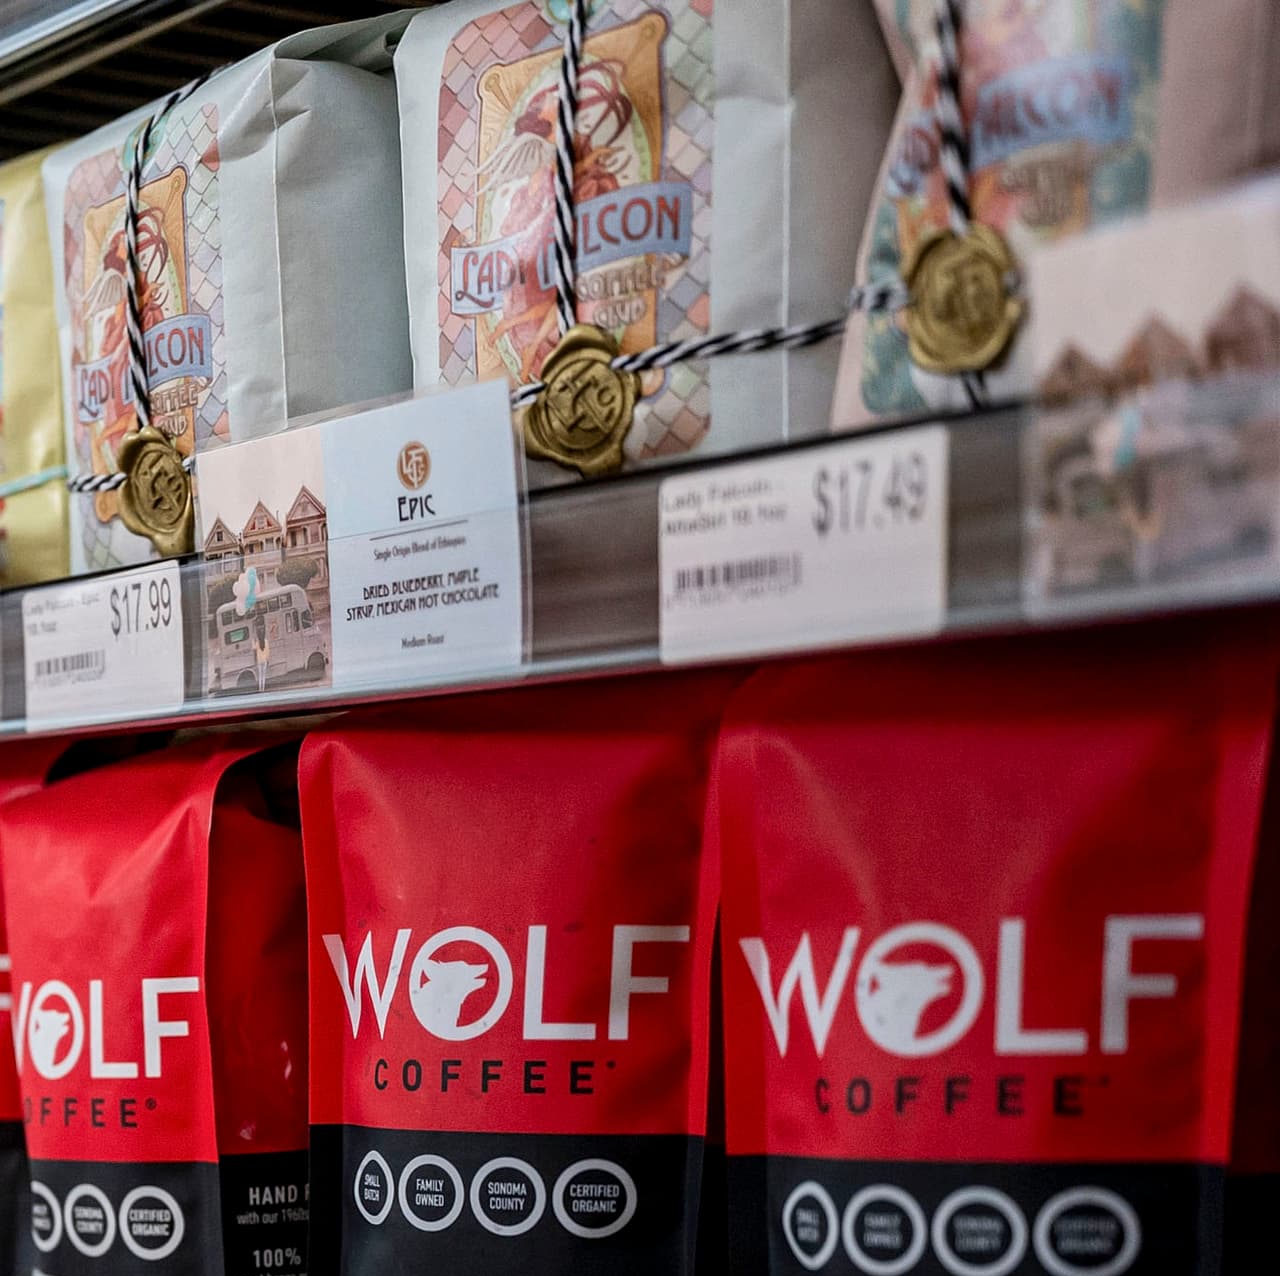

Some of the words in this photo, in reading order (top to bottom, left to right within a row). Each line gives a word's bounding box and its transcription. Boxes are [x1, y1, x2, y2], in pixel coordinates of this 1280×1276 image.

[812, 450, 928, 539] $17.49
[397, 494, 435, 522] EPIC
[362, 584, 390, 601] DRIED
[447, 567, 480, 585] MAPLE
[109, 577, 173, 640] $17.99
[376, 596, 417, 617] MEXICAN
[419, 594, 439, 610] HOT
[441, 583, 500, 606] CHOCOLATE
[322, 925, 690, 1041] WOLF
[739, 914, 1204, 1058] WOLF
[15, 977, 200, 1079] OLF
[374, 1059, 594, 1094] COFFEE
[814, 1076, 1085, 1116] COFFEE
[364, 1174, 381, 1188] SMALL
[416, 1178, 444, 1192] FAMILY
[487, 1181, 527, 1196] SONOMA
[569, 1184, 620, 1198] CERTIFIED
[248, 1184, 298, 1207] HAND
[364, 1188, 380, 1202] BATCH
[415, 1194, 445, 1207] OWNED
[489, 1197, 525, 1212] COUNTY
[129, 1209, 172, 1223] CERTIFIED
[572, 1199, 618, 1214] ORGANIC
[236, 1210, 260, 1226] with
[261, 1212, 279, 1225] our
[131, 1223, 170, 1237] ORGANIC
[253, 1247, 302, 1269] 100%
